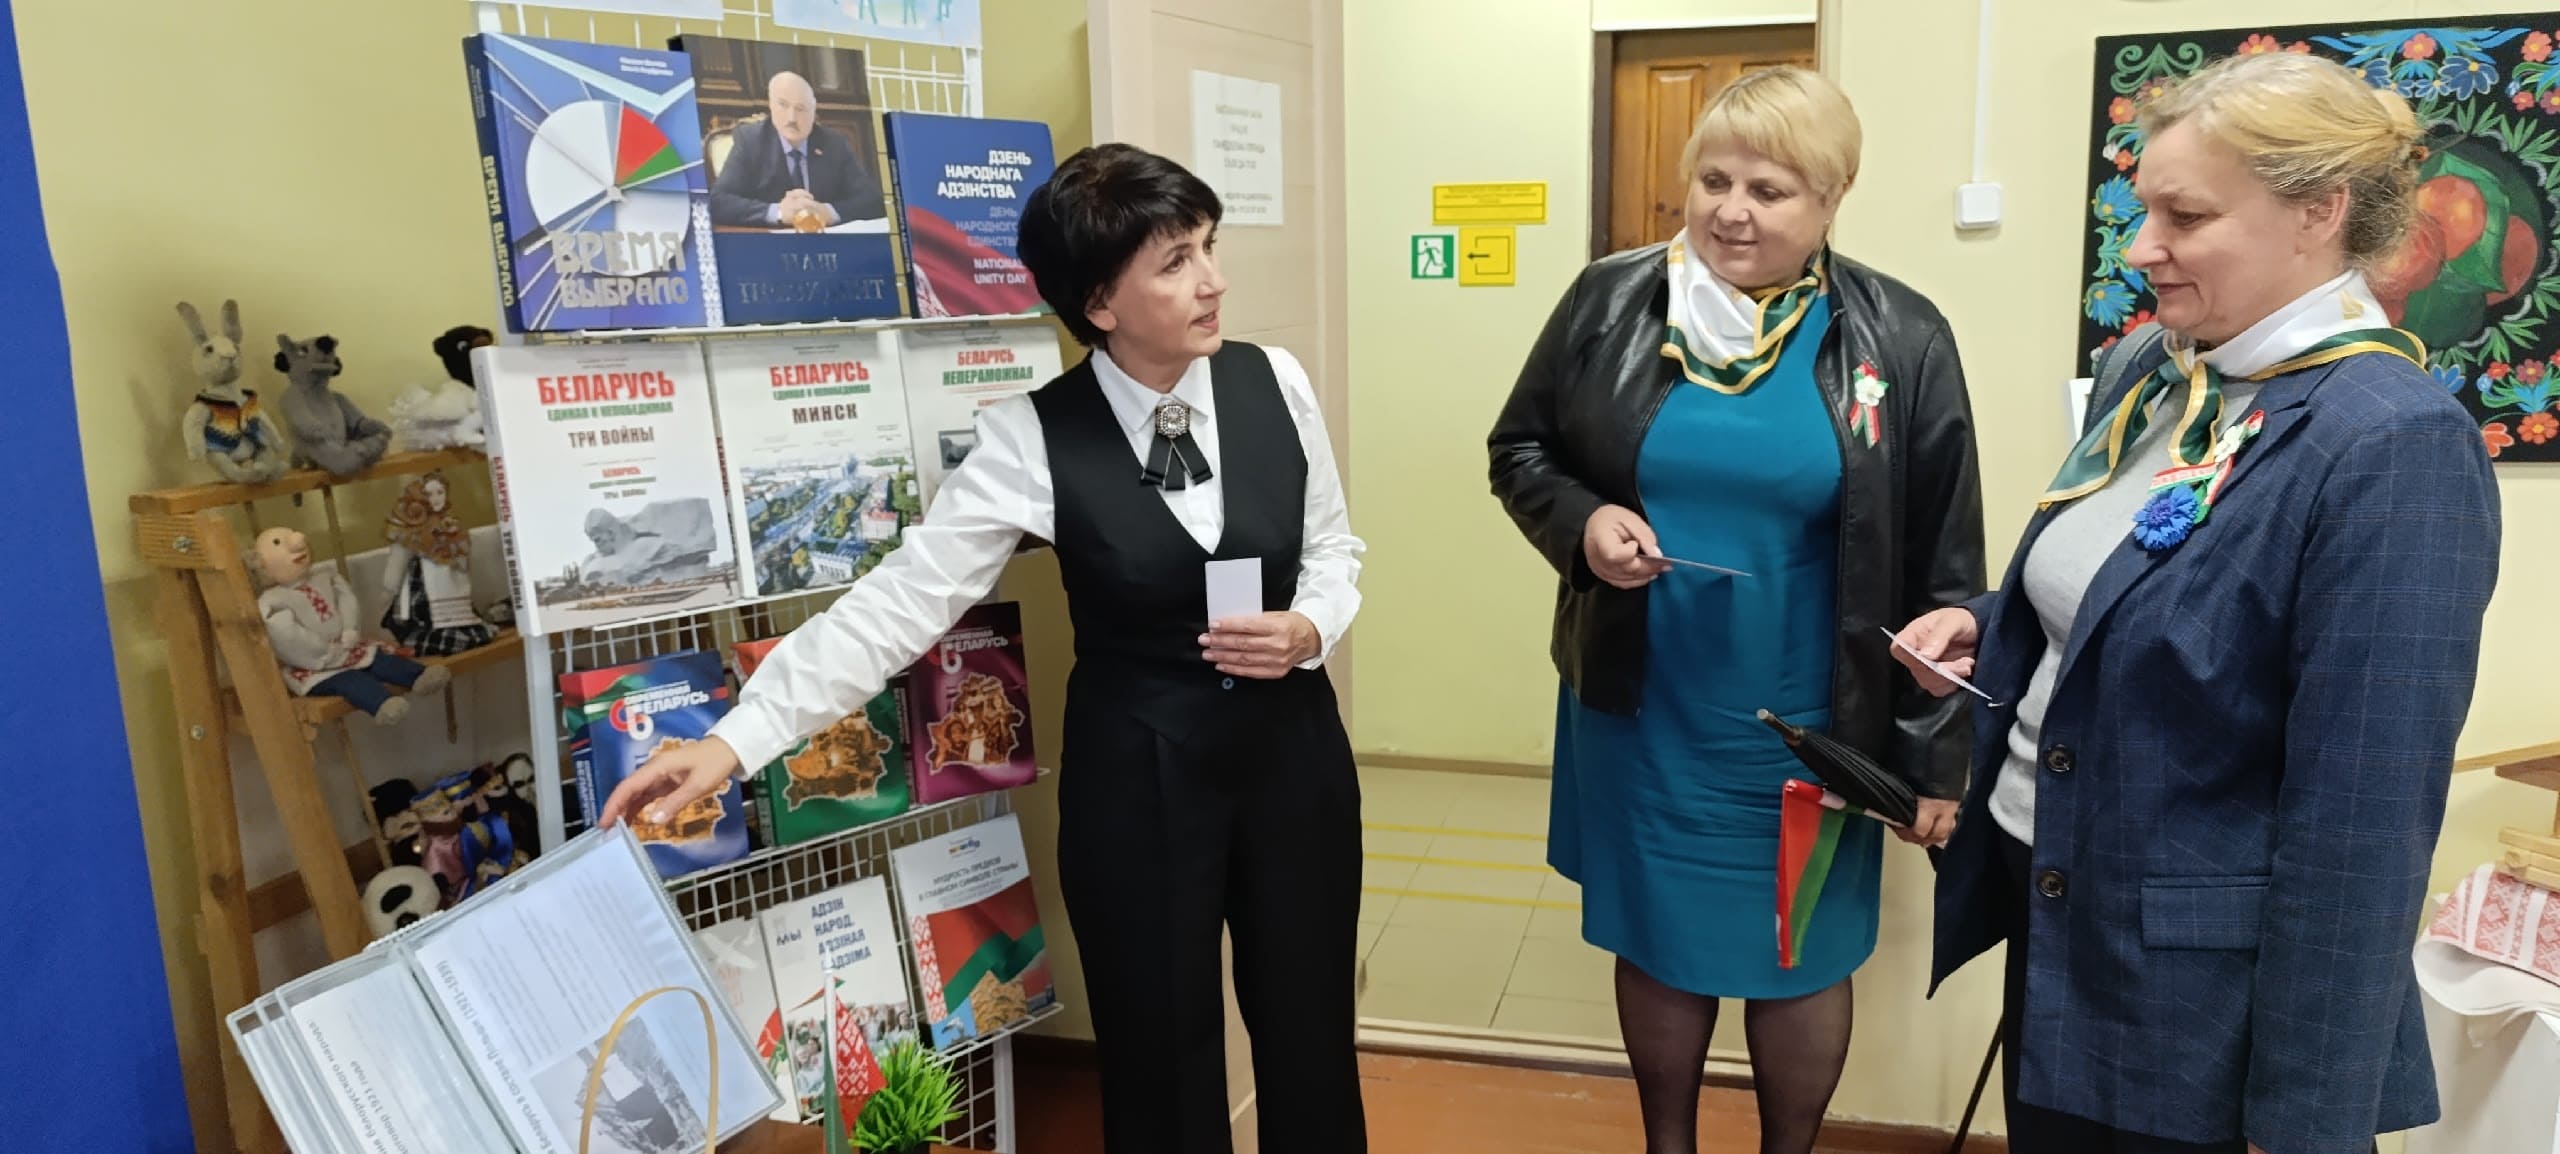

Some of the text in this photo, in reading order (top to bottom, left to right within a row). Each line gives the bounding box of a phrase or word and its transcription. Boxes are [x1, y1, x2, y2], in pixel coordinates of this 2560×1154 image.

[989, 150, 1032, 166] ДЗЕНЬ
[945, 164, 1023, 182] НАРОДНАГА
[937, 182, 1016, 199] АДЗІНСТВА
[990, 206, 1018, 218] ДЕНЬ
[550, 231, 686, 273] ВРЕМЯ
[967, 235, 1018, 248] ЕДИНСТВ
[974, 273, 1027, 284] UNITY DAY
[560, 277, 689, 308] ВЫБРАЛО
[958, 348, 1015, 366] БЕЛАРУСЬ
[770, 361, 870, 387] БЕЛАРУСЬ
[537, 370, 675, 405] БЕЛАРУСЬ
[792, 403, 858, 424] МИНСК
[567, 425, 655, 449] ТРИ ВОЙНЫ
[811, 897, 844, 919] АДЗІН
[821, 945, 872, 970] АДЗІМА
